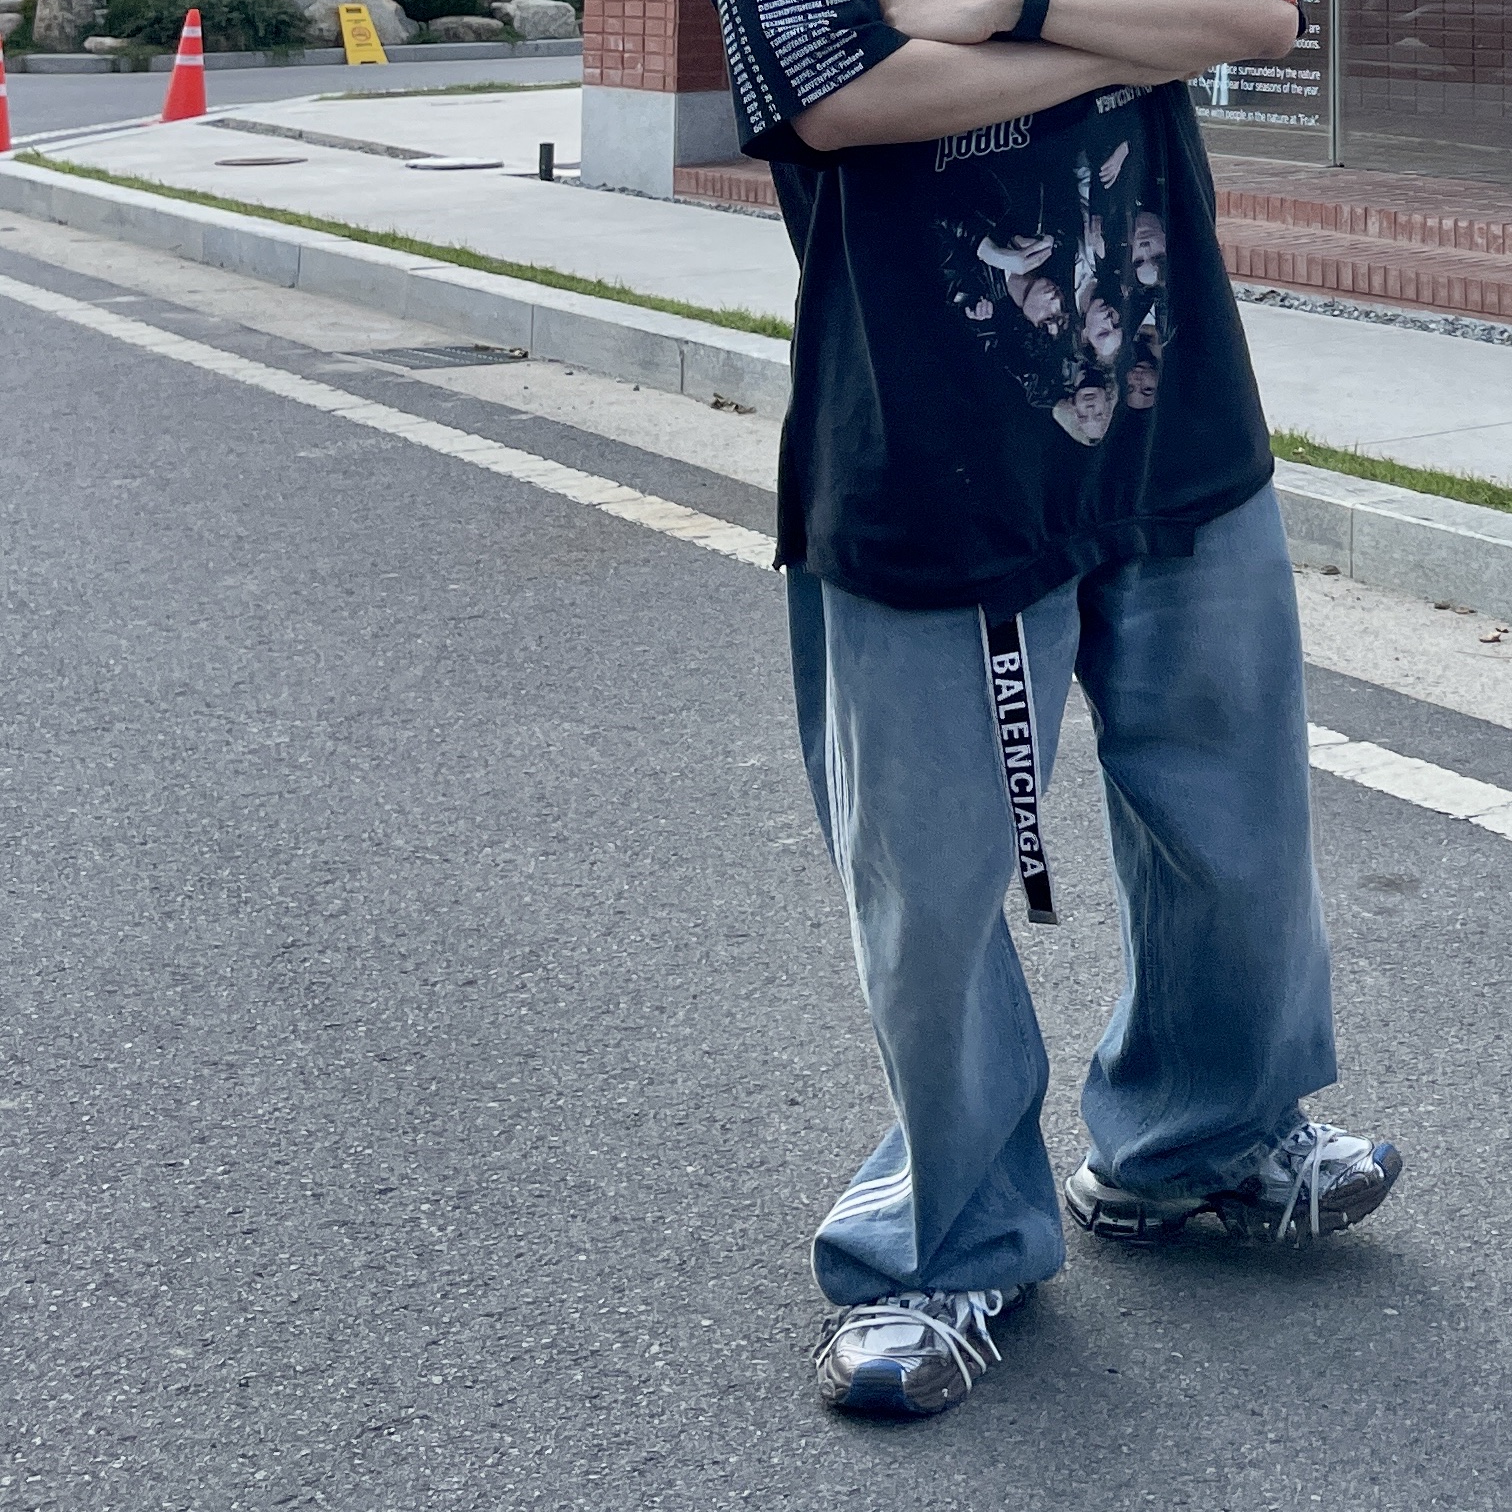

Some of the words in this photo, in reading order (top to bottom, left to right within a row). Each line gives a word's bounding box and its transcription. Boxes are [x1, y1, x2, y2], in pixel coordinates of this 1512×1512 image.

[1308, 24, 1321, 34] are
[1238, 65, 1275, 78] surrounded
[1276, 66, 1285, 80] by
[1285, 67, 1297, 79] the
[1297, 69, 1321, 81] nature
[1240, 78, 1254, 91] four
[1255, 82, 1282, 93] seasons
[1282, 82, 1290, 94] of
[1291, 83, 1303, 95] the
[1225, 109, 1247, 122] people
[1254, 111, 1266, 122] the
[992, 651, 1046, 878] BALENCIAGA
